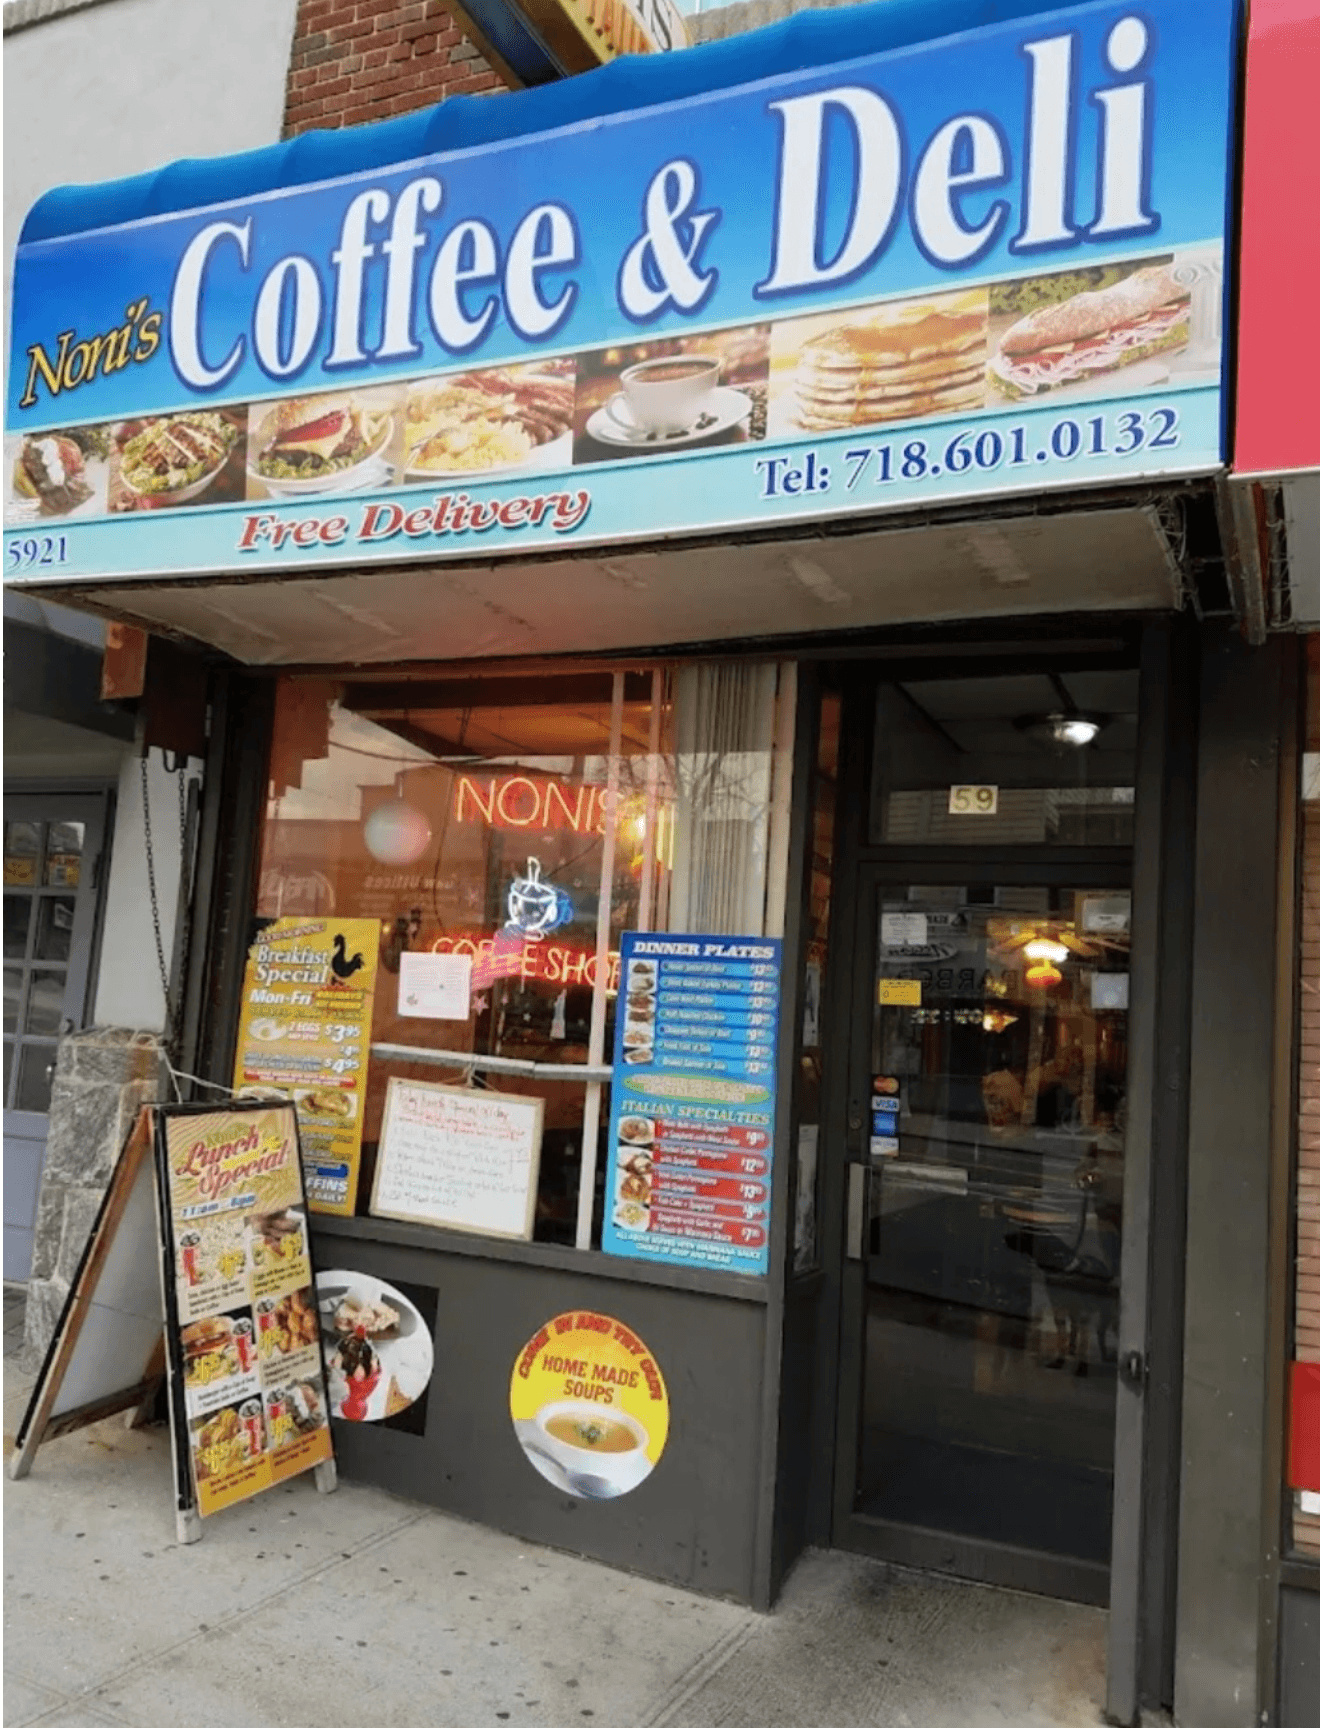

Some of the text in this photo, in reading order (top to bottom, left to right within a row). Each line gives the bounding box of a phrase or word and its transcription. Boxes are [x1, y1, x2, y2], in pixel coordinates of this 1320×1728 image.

[171, 16, 1155, 389] Coffee & Deli
[20, 298, 163, 408] Noni's
[757, 409, 1179, 497] Tel: 718.601.0132
[239, 489, 591, 551] Free Delivery
[7, 536, 68, 567] 5921
[952, 785, 994, 811] 59
[257, 944, 327, 964] Breakfast
[632, 940, 775, 959] DINNER PLATES
[256, 962, 328, 986] Special
[621, 1099, 675, 1116] ITALIAN
[175, 1124, 260, 1176] Lunch
[198, 1138, 290, 1200] Special
[305, 1176, 348, 1193] FFINS
[542, 1354, 640, 1389] HOME MADE
[562, 1378, 615, 1404] SOUPS
